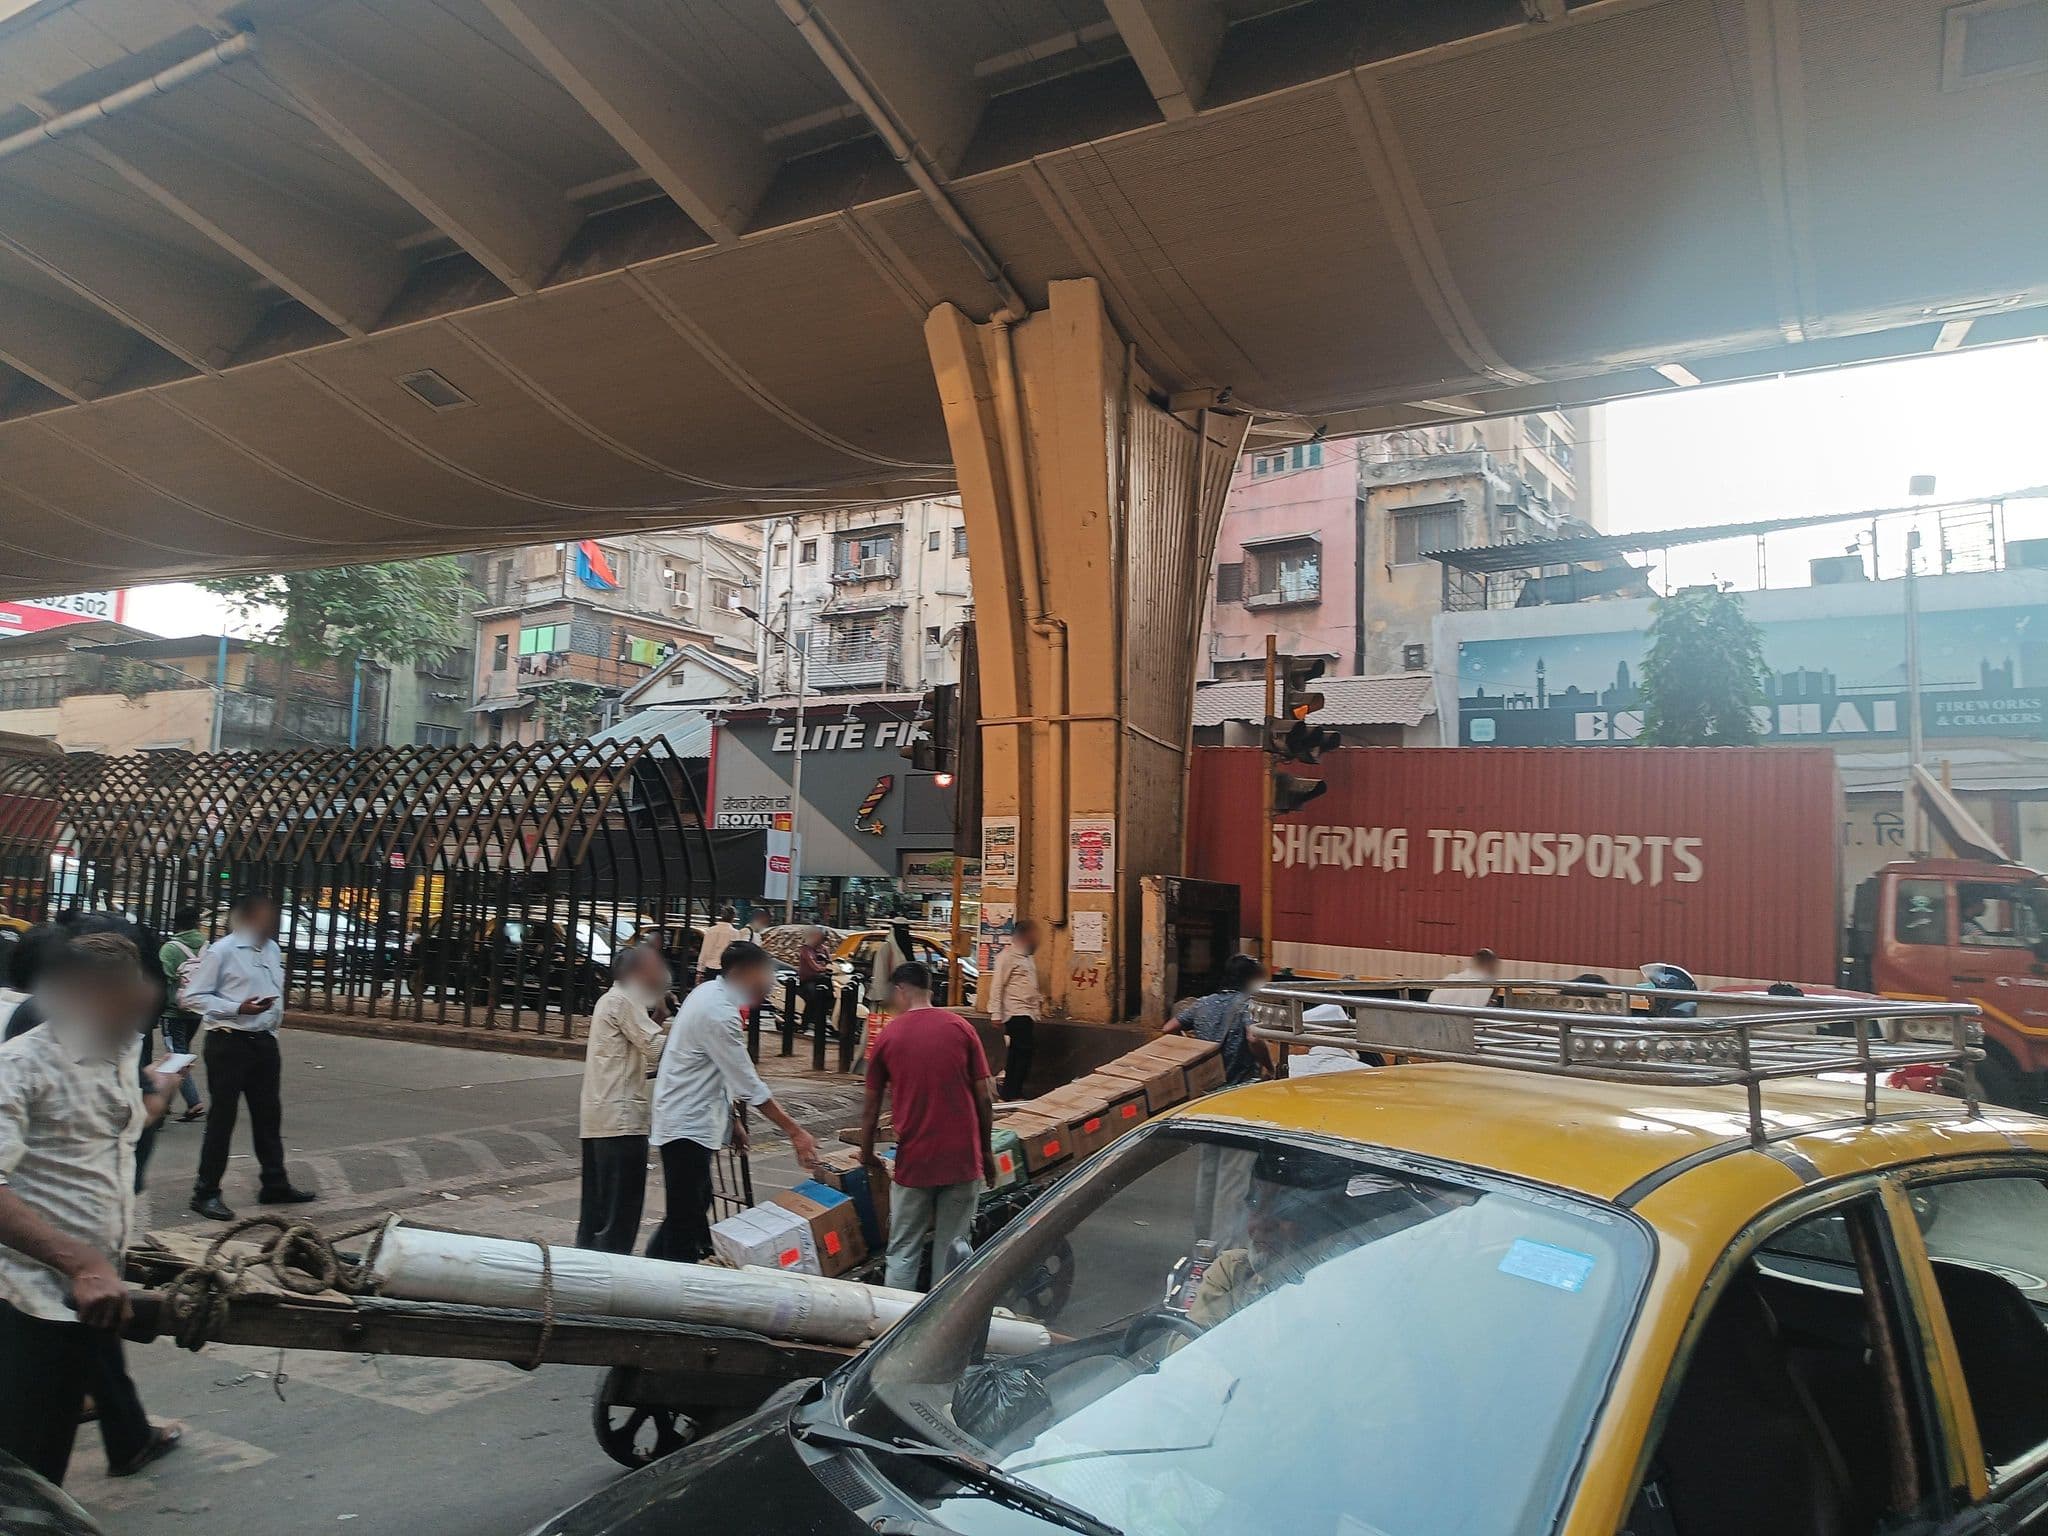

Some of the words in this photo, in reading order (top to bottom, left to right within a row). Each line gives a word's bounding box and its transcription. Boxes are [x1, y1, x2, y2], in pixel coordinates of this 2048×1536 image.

[73, 596, 107, 616] 502
[1936, 698, 2041, 712] FIREWORKS
[1936, 715, 1950, 726] &
[1953, 713, 2041, 726] CRACKERS
[772, 723, 865, 751] ELITE
[719, 814, 773, 825] ROYAL
[1272, 824, 1408, 872] SHARMA
[1428, 829, 1703, 887] TRANSPORTS
[1072, 967, 1098, 988] 47
